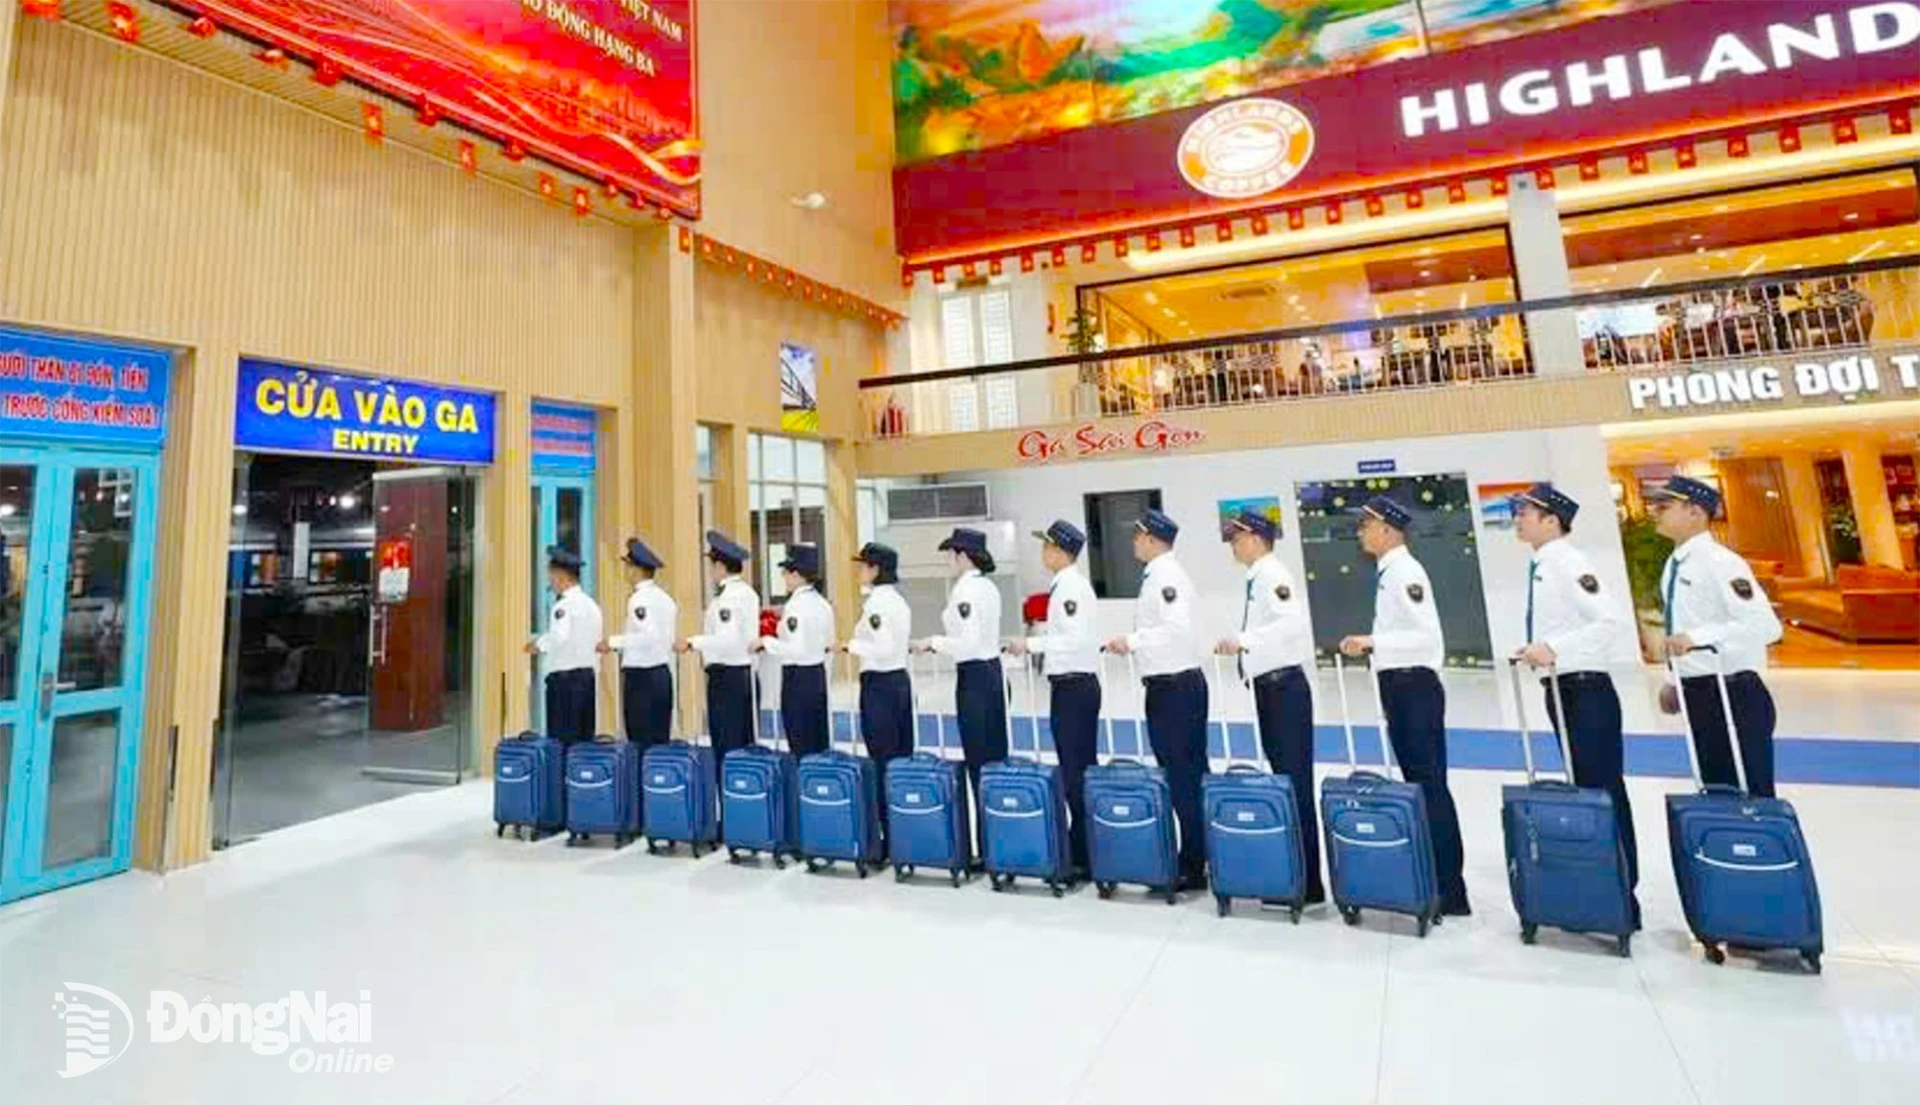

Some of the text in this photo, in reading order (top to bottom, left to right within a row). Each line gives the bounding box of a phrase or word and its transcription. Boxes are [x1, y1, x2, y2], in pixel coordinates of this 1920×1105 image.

[652, 8, 682, 42] NAM
[636, 50, 655, 77] BA
[1402, 3, 1920, 138] HIGHLAND
[1793, 354, 1881, 402] ĐỢI
[255, 370, 343, 421] CỬA
[353, 384, 427, 430] VÀO
[434, 400, 479, 434] GA
[332, 427, 419, 455] ENTRY
